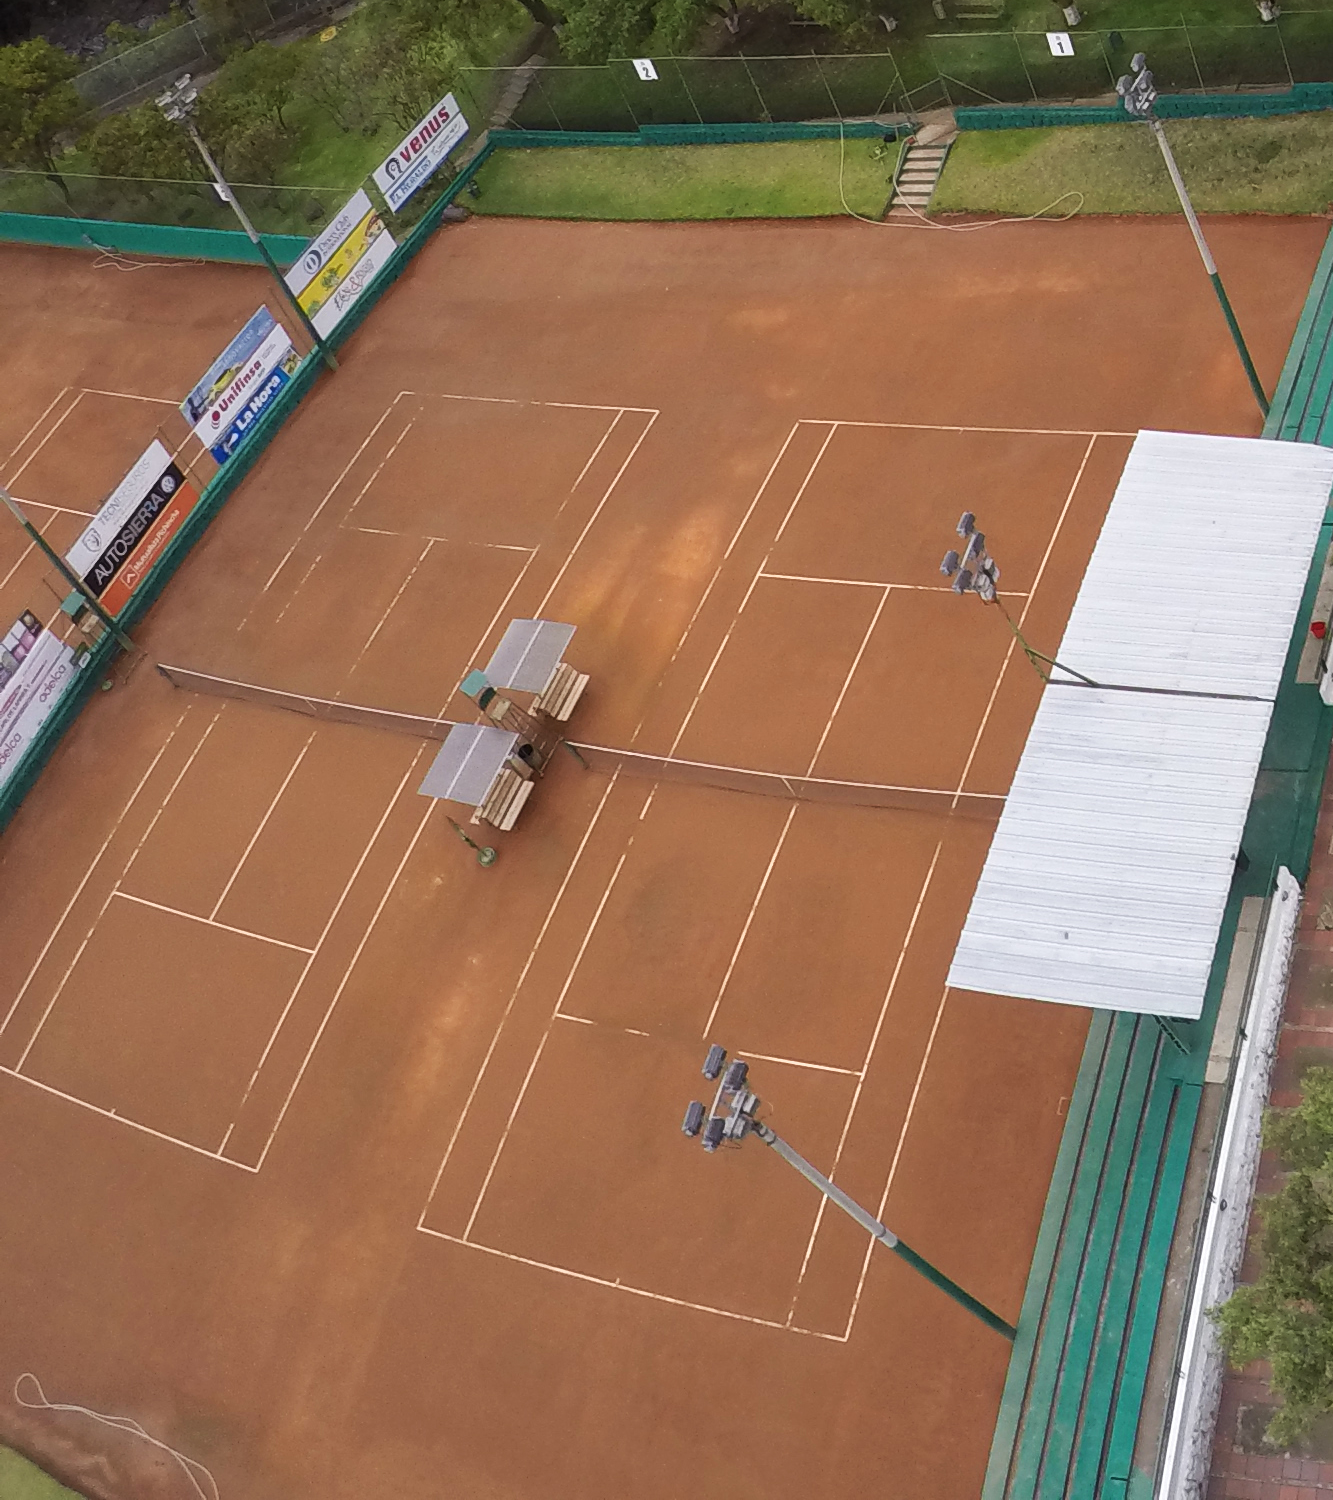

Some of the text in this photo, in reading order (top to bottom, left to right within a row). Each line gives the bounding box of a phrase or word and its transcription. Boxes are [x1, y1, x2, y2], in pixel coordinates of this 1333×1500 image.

[1056, 41, 1065, 54] 1
[642, 66, 652, 78] 2
[399, 105, 450, 163] venus
[218, 360, 262, 412] Unifinsa
[235, 410, 255, 432] La
[94, 492, 166, 586] AUTOSIERRA
[39, 664, 67, 703] adelca
[0, 732, 22, 765] delca
